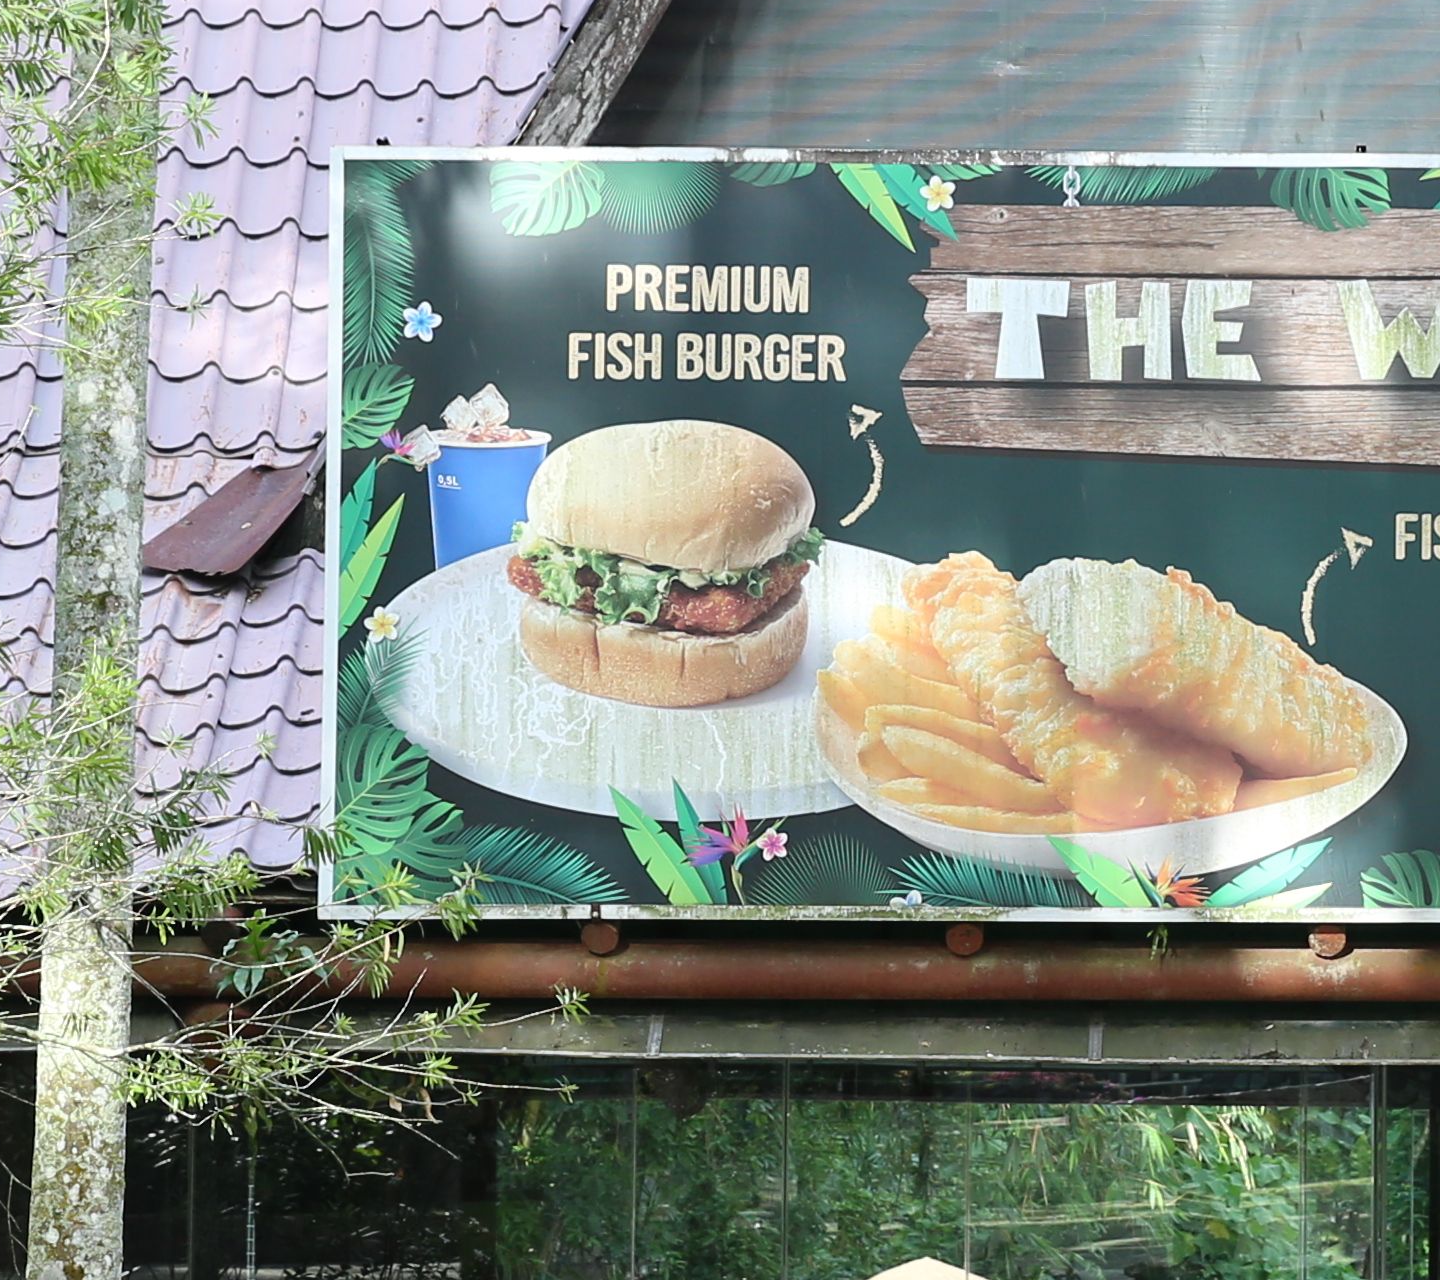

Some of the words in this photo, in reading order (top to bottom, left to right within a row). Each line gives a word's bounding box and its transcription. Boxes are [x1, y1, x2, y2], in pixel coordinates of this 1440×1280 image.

[605, 264, 810, 313] PREMIUM
[965, 276, 1262, 382] THE
[567, 332, 662, 380] FISH
[676, 333, 847, 382] BURGER
